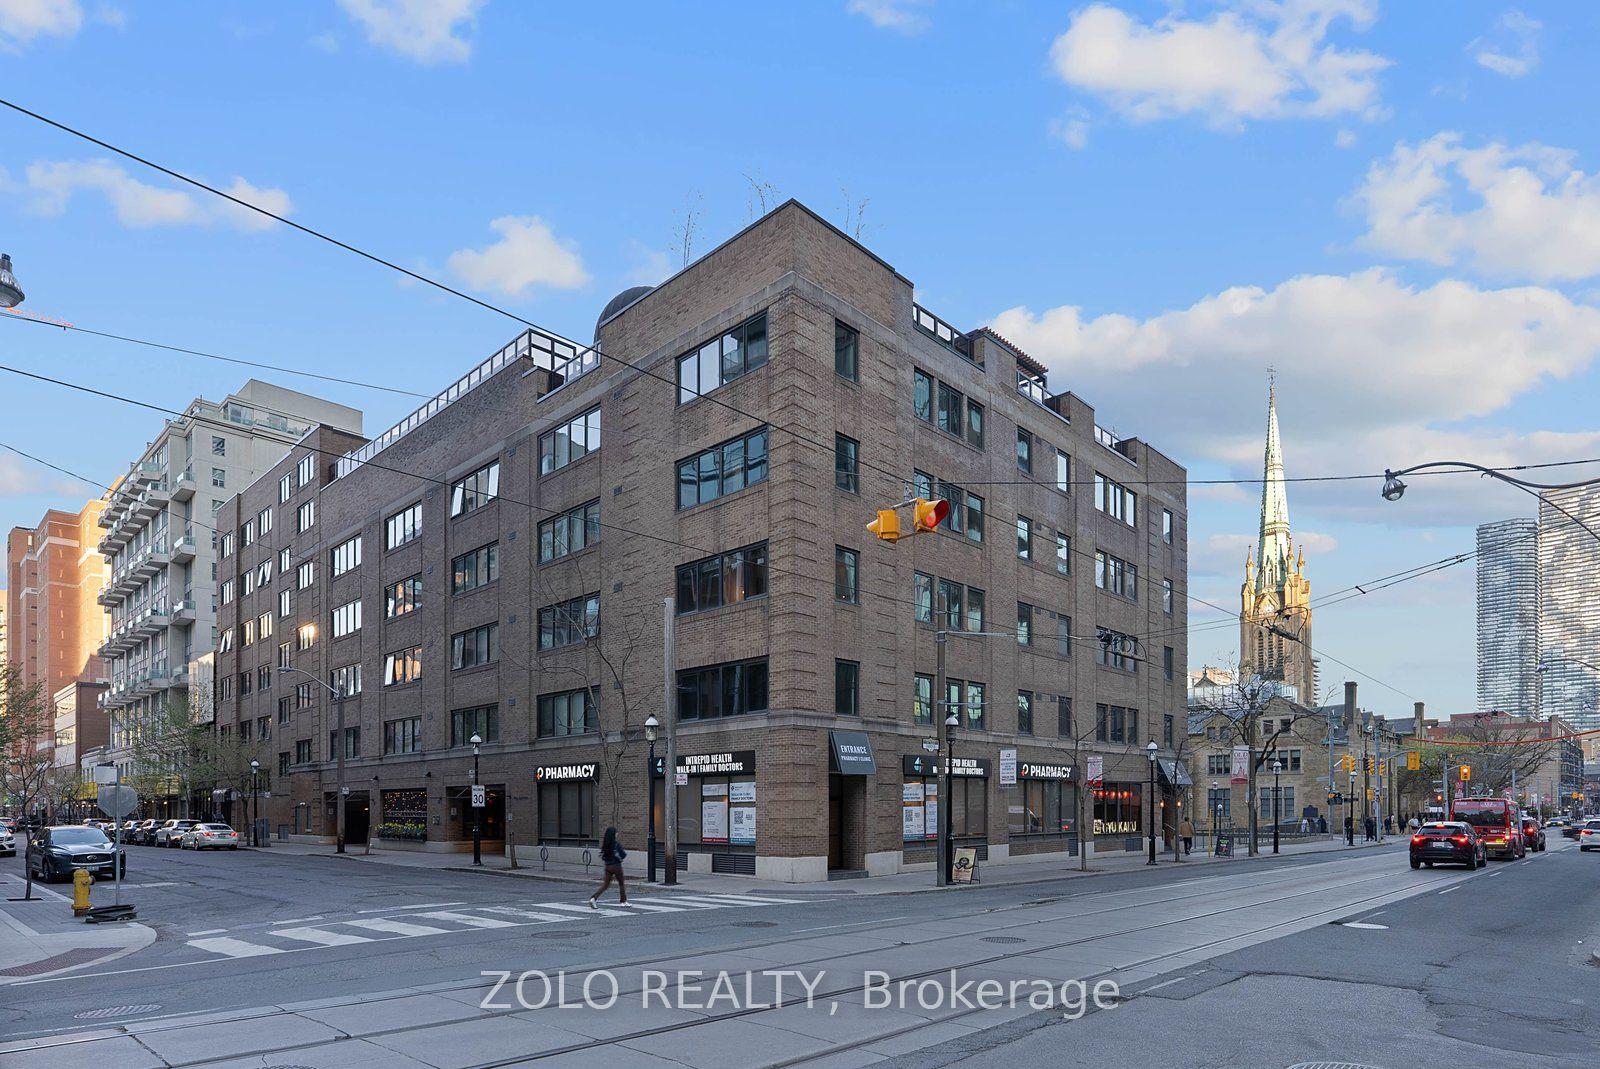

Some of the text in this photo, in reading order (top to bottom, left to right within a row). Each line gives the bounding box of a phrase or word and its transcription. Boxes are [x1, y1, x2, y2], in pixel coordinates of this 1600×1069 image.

[840, 745, 867, 754] ENTRANCE
[685, 753, 732, 765] INTREPID HEALTH
[545, 764, 595, 779] PHARMACY
[700, 764, 717, 773] FAMILY
[718, 762, 743, 772] DOCTORS
[1030, 765, 1071, 778] PHARMACY
[473, 794, 484, 804] 30
